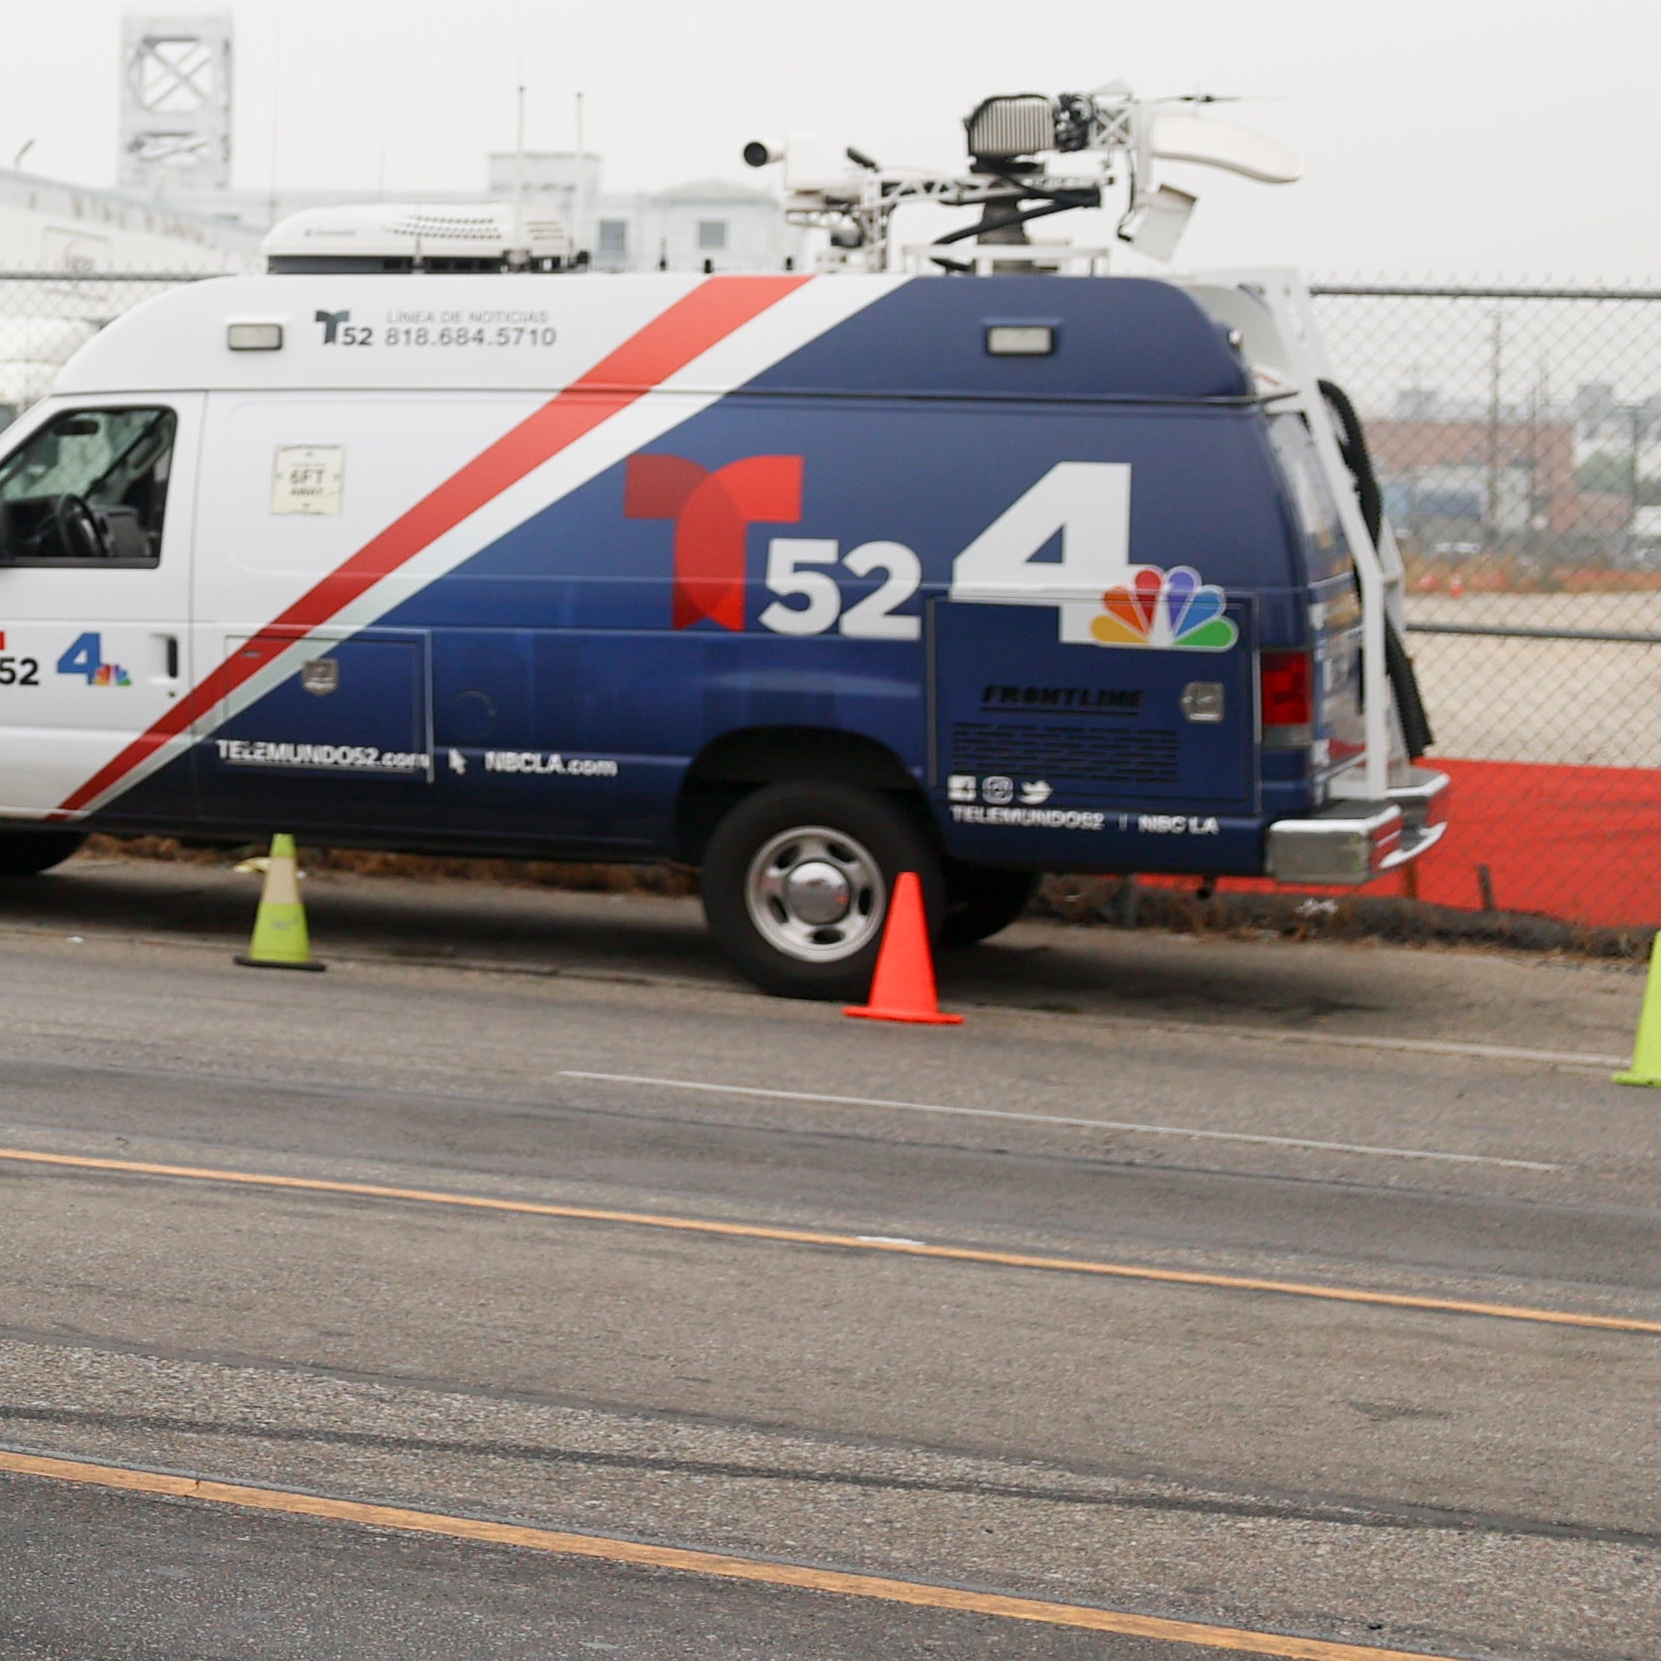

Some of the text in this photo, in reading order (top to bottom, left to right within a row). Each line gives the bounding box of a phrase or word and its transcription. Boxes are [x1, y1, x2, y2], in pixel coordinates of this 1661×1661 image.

[440, 310, 463, 324] DE
[469, 310, 549, 324] NOTICIAS
[342, 327, 373, 346] 52
[384, 327, 557, 346] 818.684.5710
[290, 468, 326, 485] 6FT
[758, 537, 922, 641] 52
[949, 460, 1132, 645] 4
[56, 632, 101, 685] 4
[982, 685, 1144, 709] FRONTLINE
[216, 739, 618, 777] TELEMUNDO52.com NBCLA.com
[949, 806, 1220, 835] TELEMUNDO52 NBC LA
